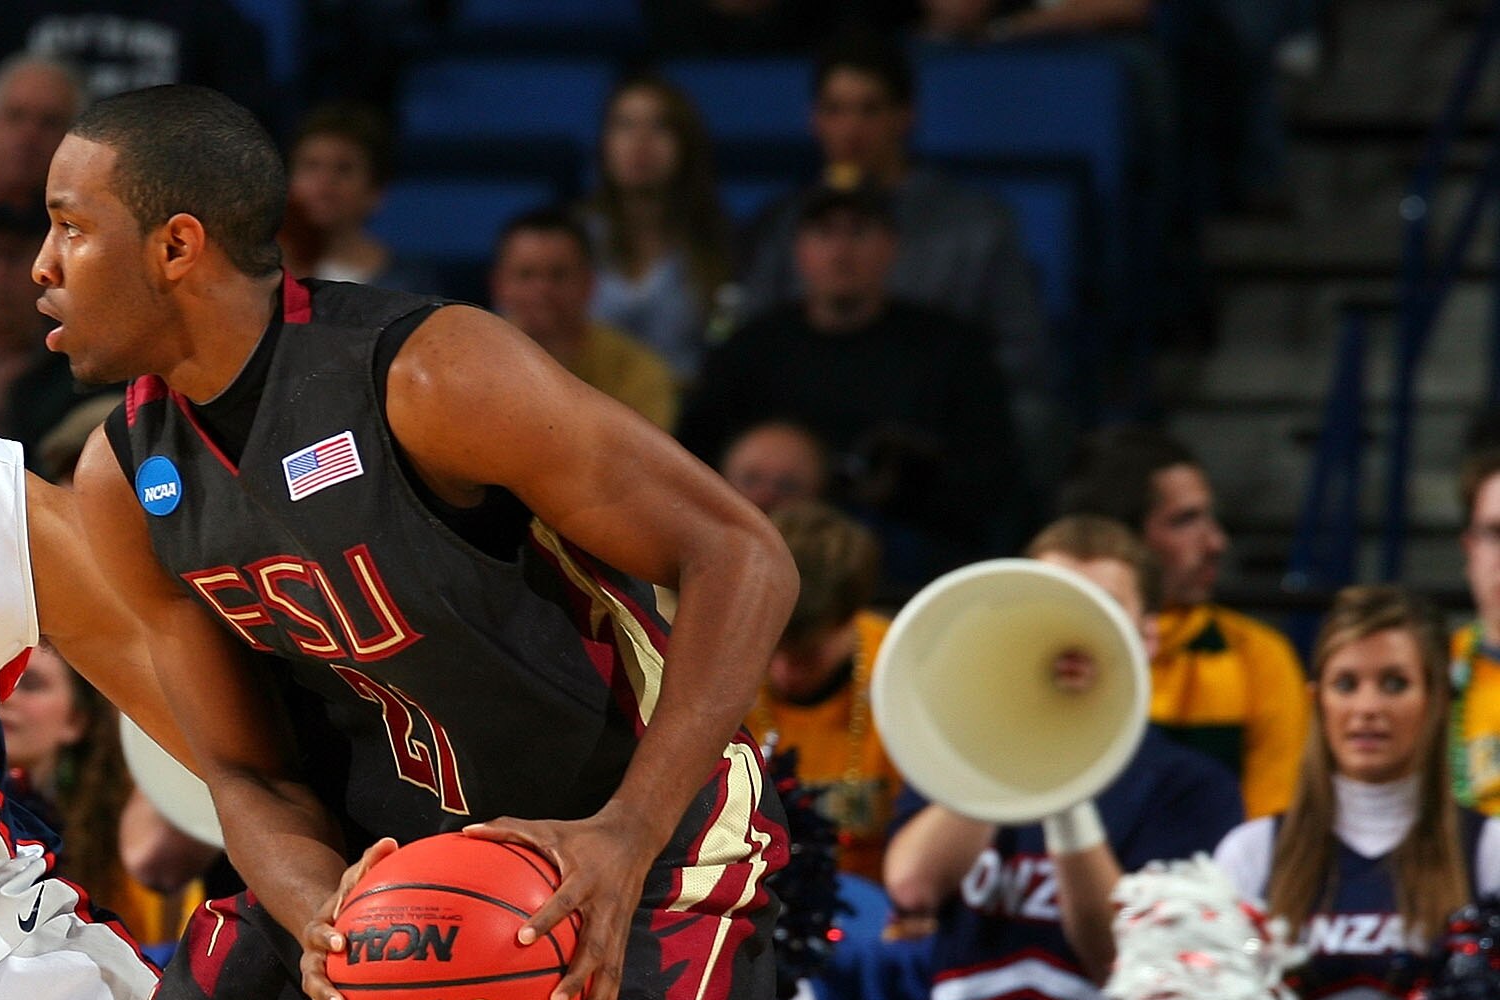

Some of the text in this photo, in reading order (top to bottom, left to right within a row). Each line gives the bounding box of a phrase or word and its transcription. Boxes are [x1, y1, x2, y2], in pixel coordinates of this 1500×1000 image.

[144, 482, 177, 503] NCAA
[180, 543, 426, 662] FSU
[346, 922, 461, 966] NCAA
